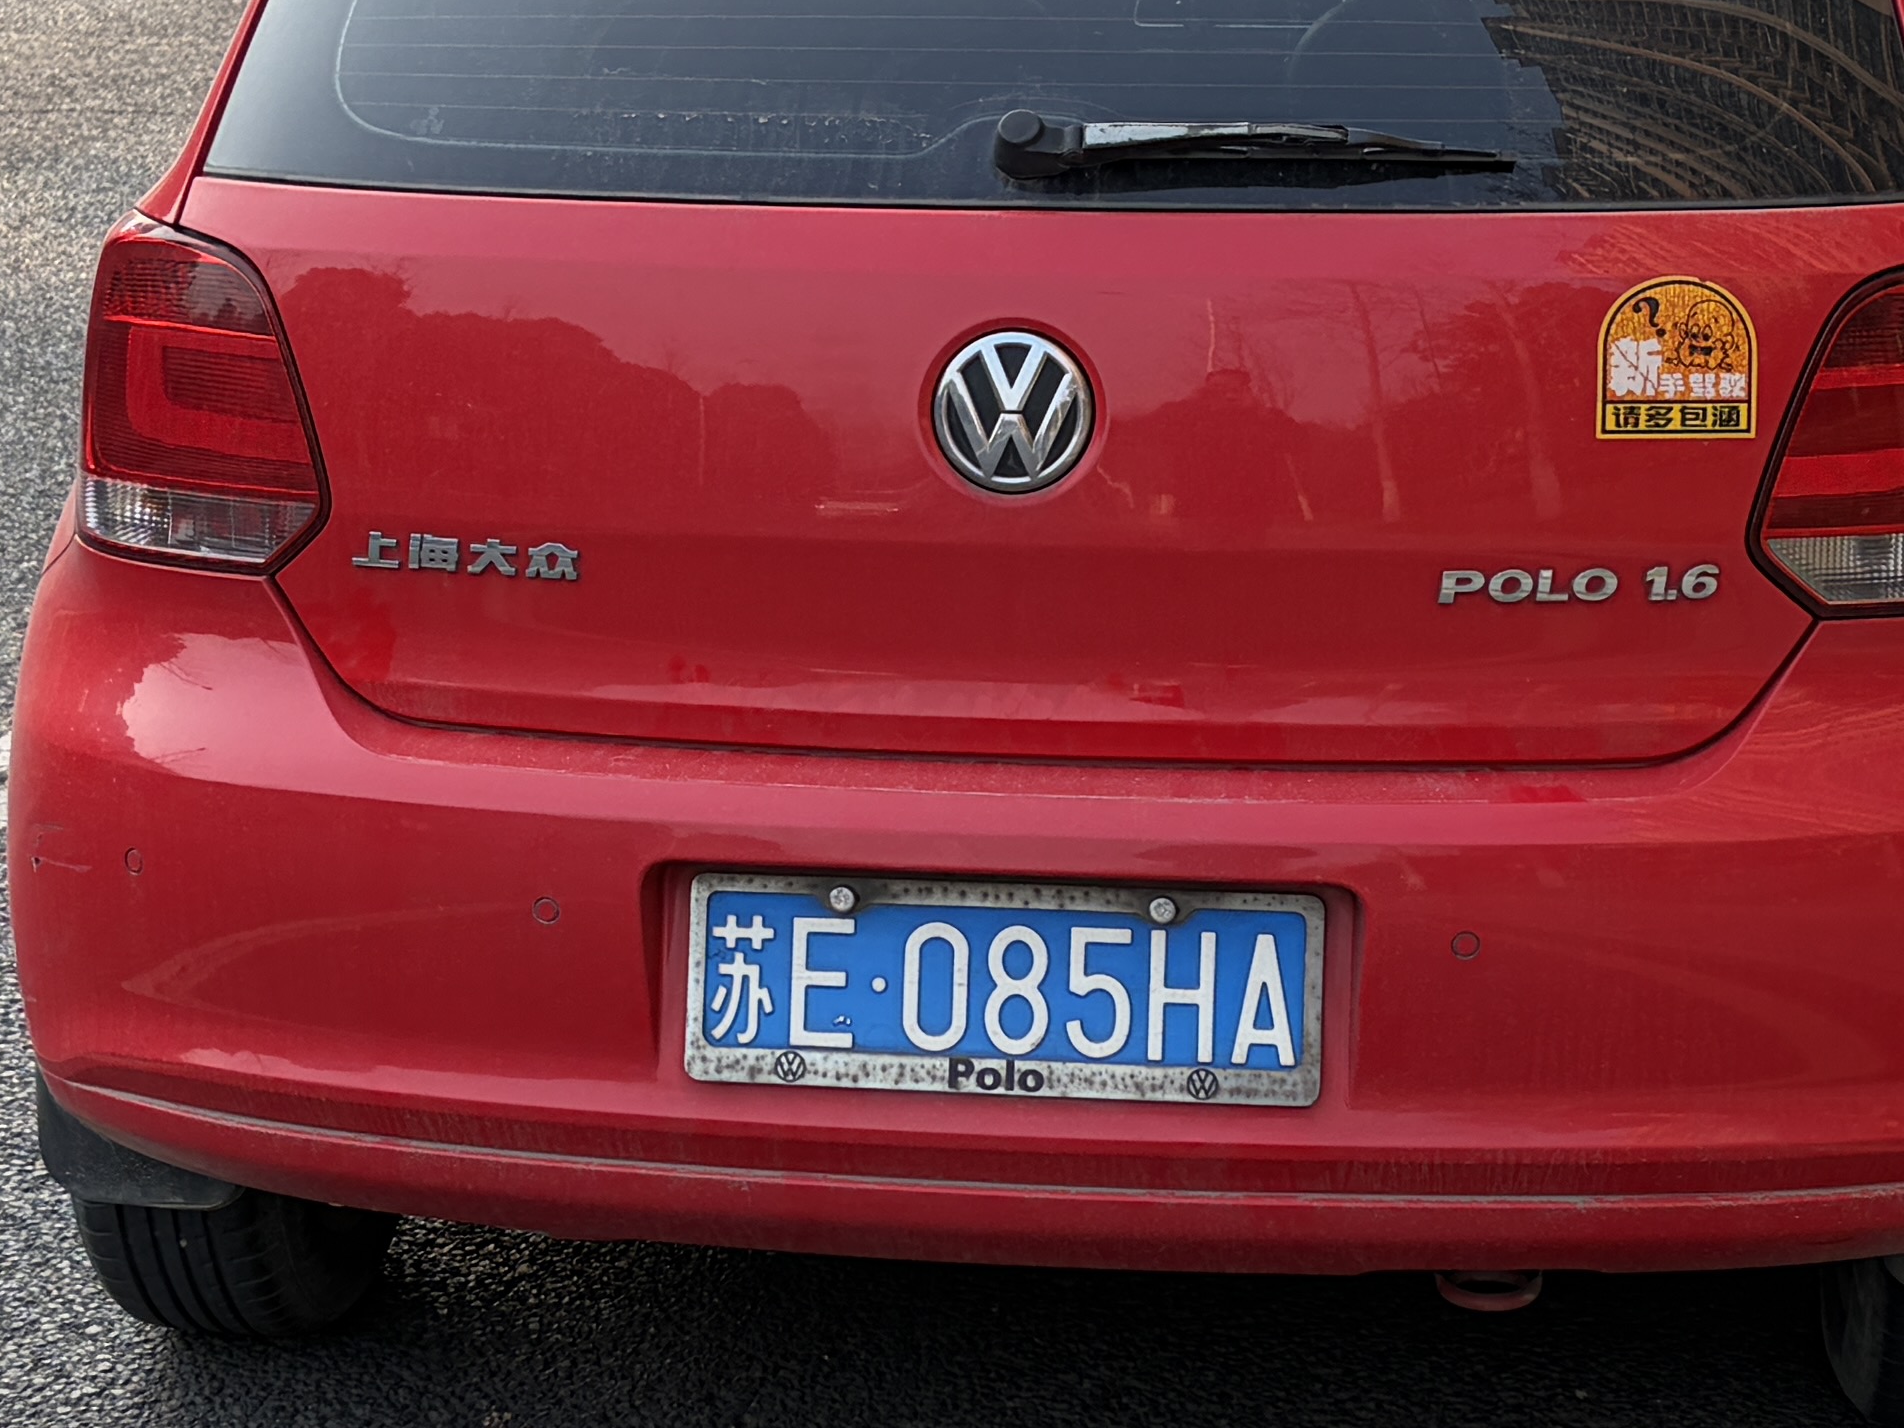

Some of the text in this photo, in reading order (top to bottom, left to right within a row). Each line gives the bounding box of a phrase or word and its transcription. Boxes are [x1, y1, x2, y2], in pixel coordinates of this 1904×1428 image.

[1611, 405, 1742, 429] 请多包涵
[351, 530, 579, 581] 上海大众
[1437, 563, 1721, 604] POLO 1.6
[946, 1057, 1045, 1093] Polo
